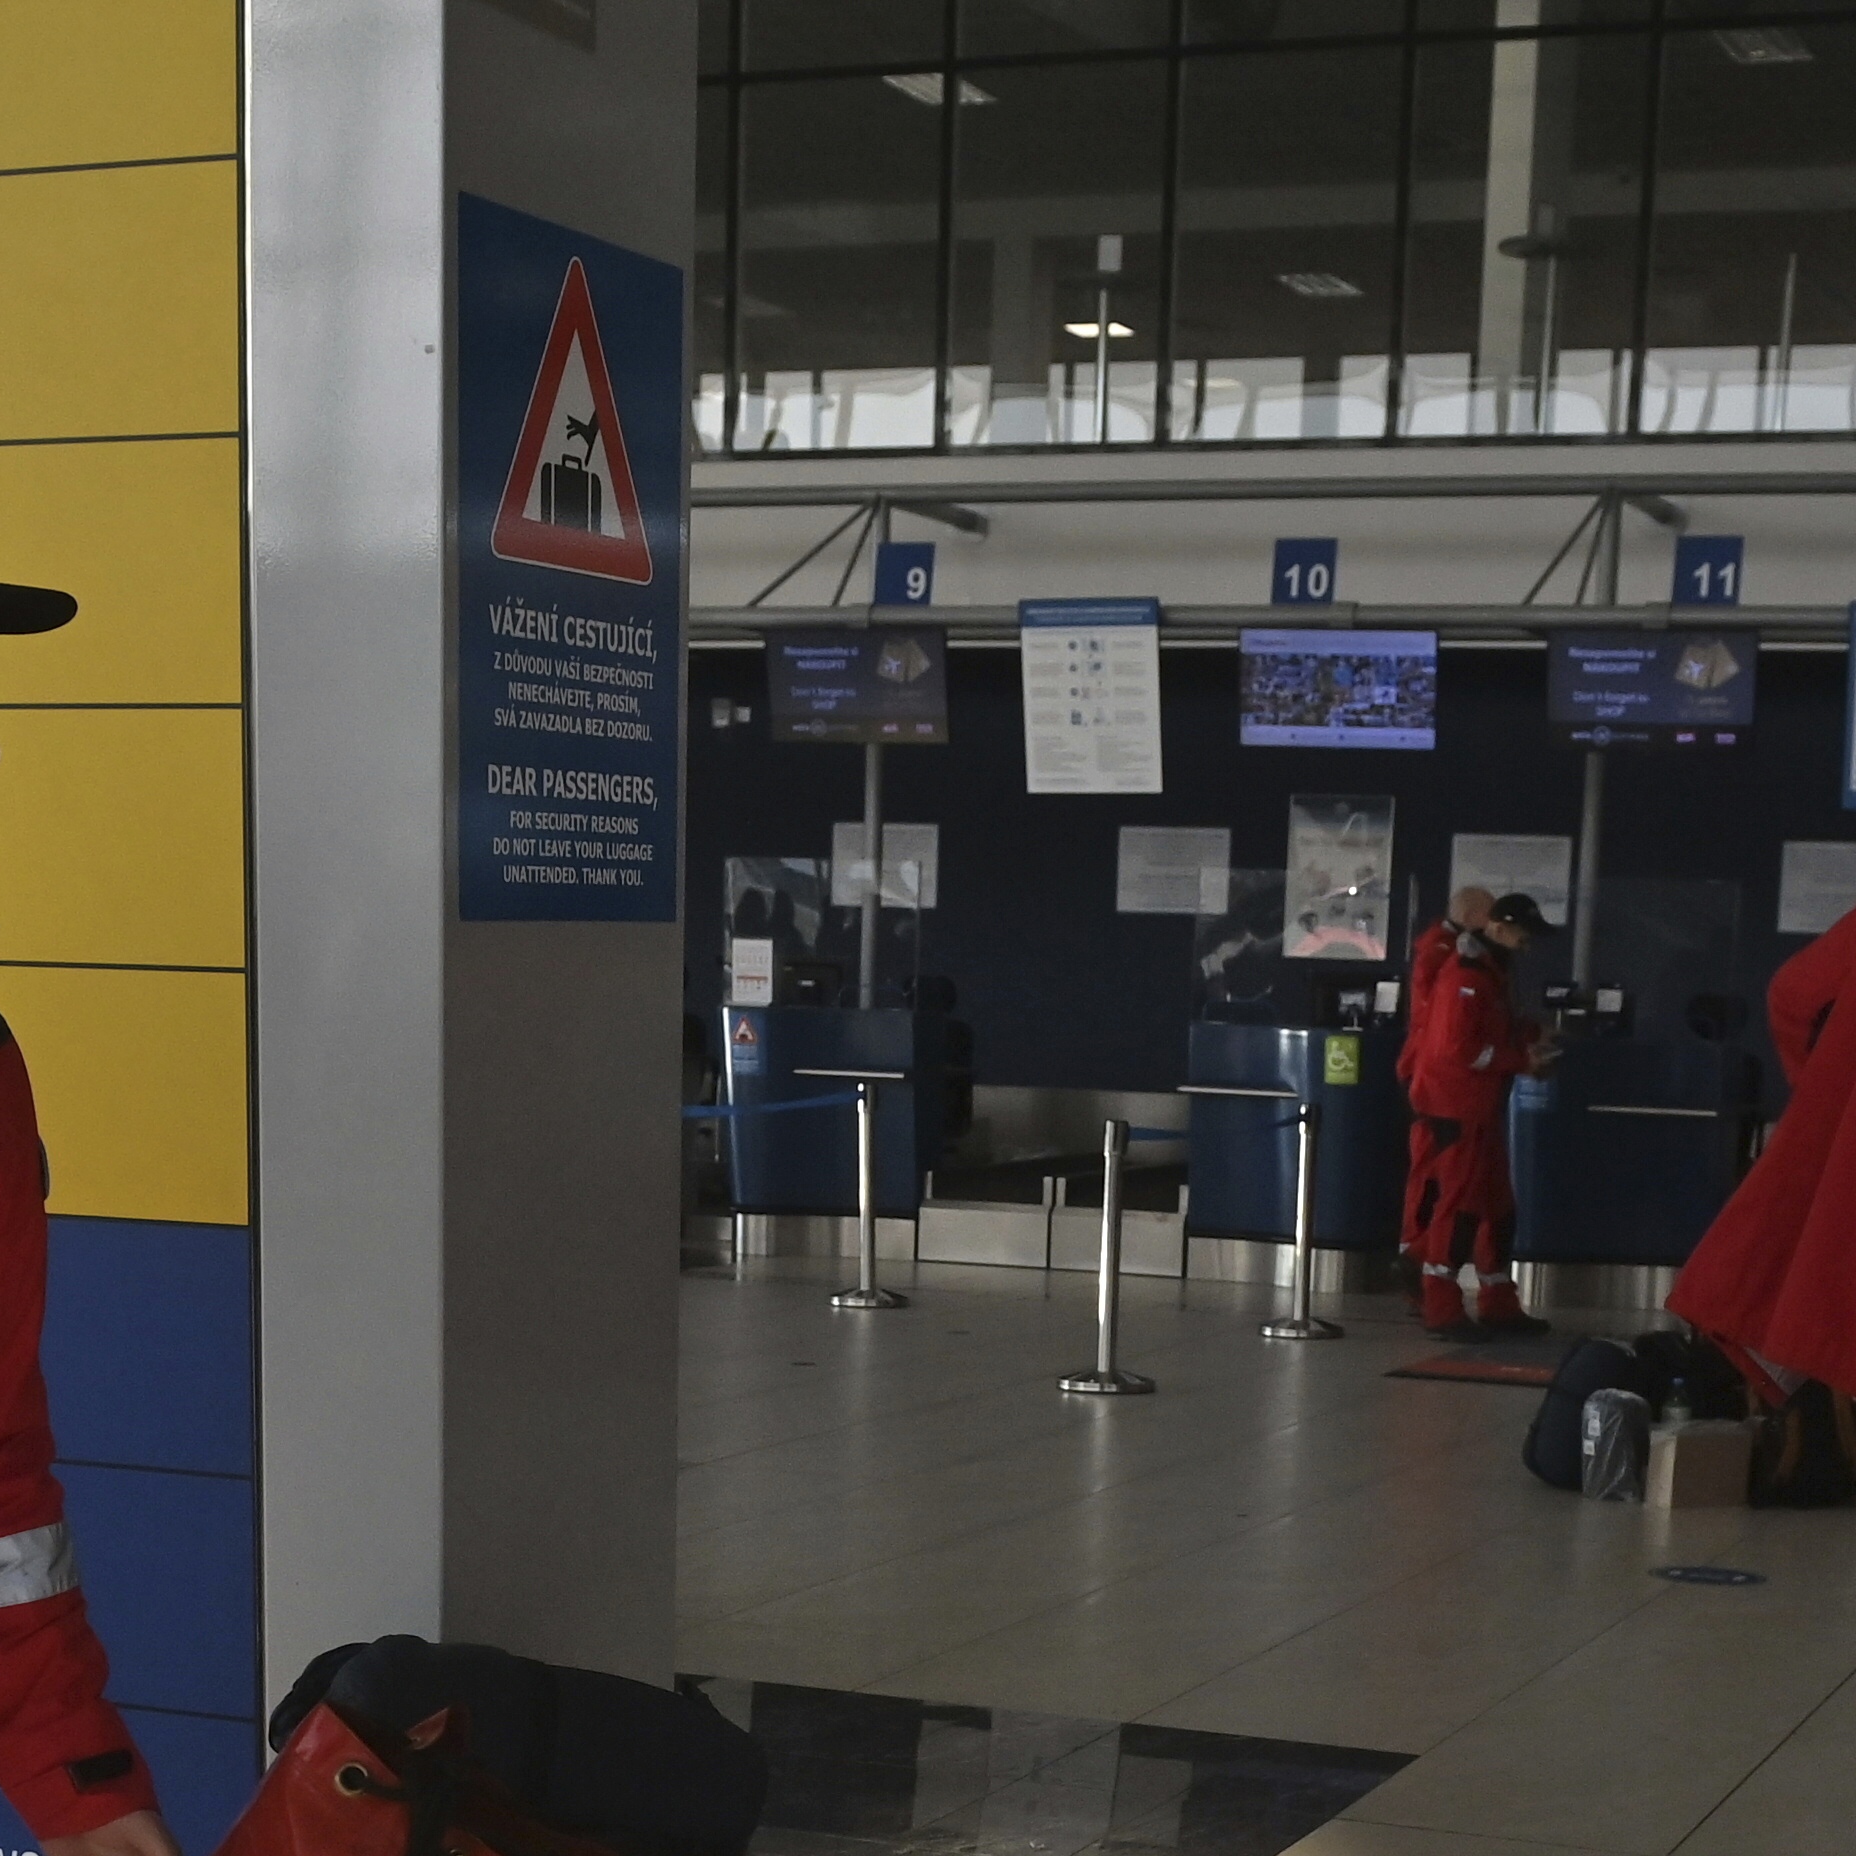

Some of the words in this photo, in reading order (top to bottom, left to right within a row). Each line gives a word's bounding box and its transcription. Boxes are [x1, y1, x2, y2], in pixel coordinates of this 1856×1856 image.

[906, 566, 927, 600] 9
[1284, 563, 1331, 598] 10
[1693, 560, 1738, 598] 11
[489, 596, 558, 643] VÁŽENÍ
[564, 615, 657, 664] CESTUJÍCÍ,
[494, 651, 502, 671] Z
[504, 648, 552, 677] DŮVODU
[555, 654, 581, 681] VAŠÍ
[583, 662, 654, 691] BEZPEČNOSTI
[494, 704, 517, 730] SVÁ
[519, 711, 582, 736] ZAVAZADLA
[585, 718, 605, 738] BEZ
[607, 721, 653, 742] DOZORU.
[488, 763, 537, 797] DEAR
[543, 768, 658, 811] PASSENGERS,
[510, 810, 532, 830] FOR
[535, 812, 588, 833] SECURITY
[591, 815, 639, 835] REASONS
[494, 837, 510, 856] DO
[512, 838, 536, 857] NOT
[538, 839, 572, 859] LEAVE
[574, 840, 604, 860] YOUR
[606, 842, 653, 862] LUGGAGE
[503, 865, 579, 885] UNATTENDED.
[582, 866, 617, 886] THANK
[619, 867, 644, 887] YOU.
